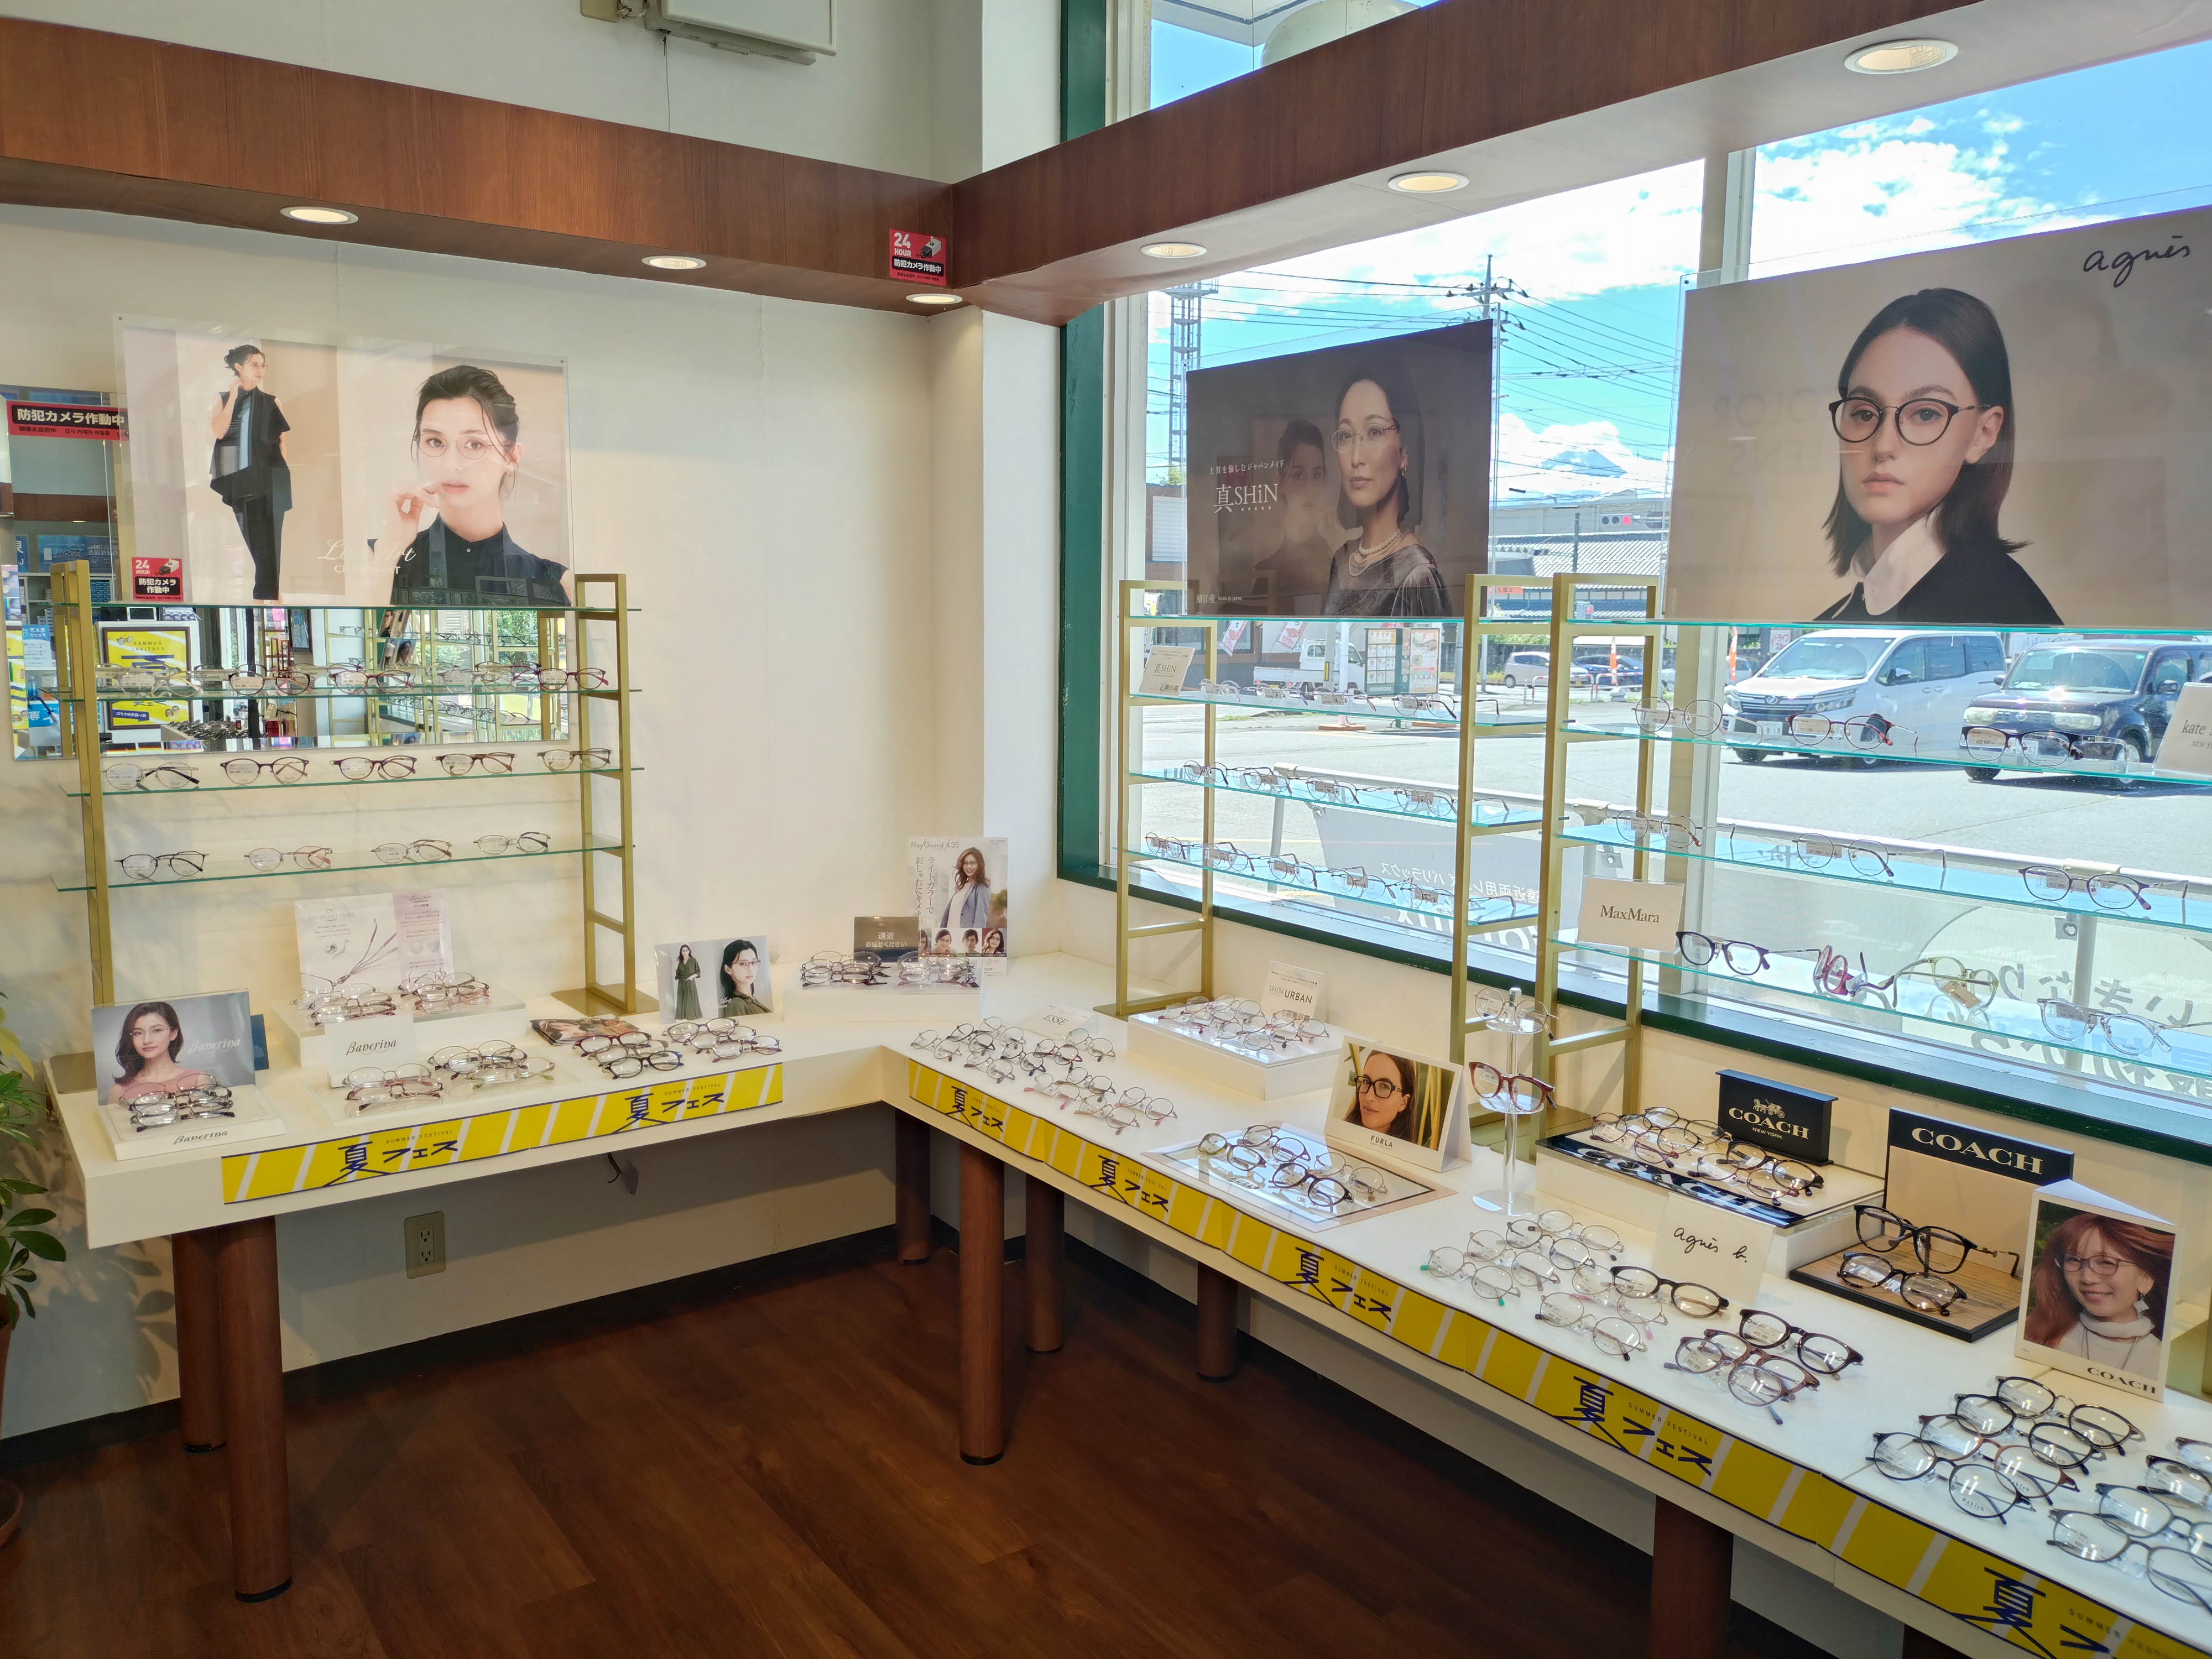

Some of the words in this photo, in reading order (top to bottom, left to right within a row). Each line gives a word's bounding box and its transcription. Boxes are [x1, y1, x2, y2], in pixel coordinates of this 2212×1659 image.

[894, 232, 911, 248] 24
[894, 248, 911, 257] HOUR
[894, 258, 942, 274] 防犯カメラ作動中
[17, 408, 124, 426] 防犯カメラ作動中
[135, 560, 150, 569] 24
[138, 578, 176, 586] 防犯カメラ
[2182, 719, 2206, 735] kate
[1599, 905, 1660, 923] MaxMara
[878, 932, 894, 940] 遠近
[1285, 990, 1312, 1004] URBAN
[1043, 1014, 1068, 1025] ESSE
[693, 1083, 721, 1091] FESTIVAL
[611, 1092, 724, 1134] 夏フェス
[945, 1086, 1003, 1133] 夏フェス
[1728, 1107, 1809, 1140] COACH
[1752, 1126, 1766, 1136] NEW
[1766, 1129, 1783, 1139] YORK
[420, 1130, 453, 1139] FESTIVAL
[1371, 1135, 1392, 1147] FURLA
[1912, 1127, 2043, 1175] COACH
[321, 1140, 458, 1187] 夏フェス
[1088, 1154, 1168, 1213] 夏フェス
[1127, 1168, 1144, 1180] SUMMER
[1146, 1178, 1166, 1191] FESTIVAL
[1281, 1246, 1391, 1323] 夏フェス
[1334, 1265, 1357, 1280] SUMMER
[1360, 1279, 1389, 1297] FESTIVAL
[2088, 1367, 2156, 1394] COACH
[1552, 1375, 1712, 1477] 夏フェス
[1628, 1401, 1662, 1423] SUMMER
[1667, 1420, 1709, 1446] FESTIVAL
[1961, 1498, 1985, 1512] Rakish
[2069, 1608, 2121, 1639] SUMMER
